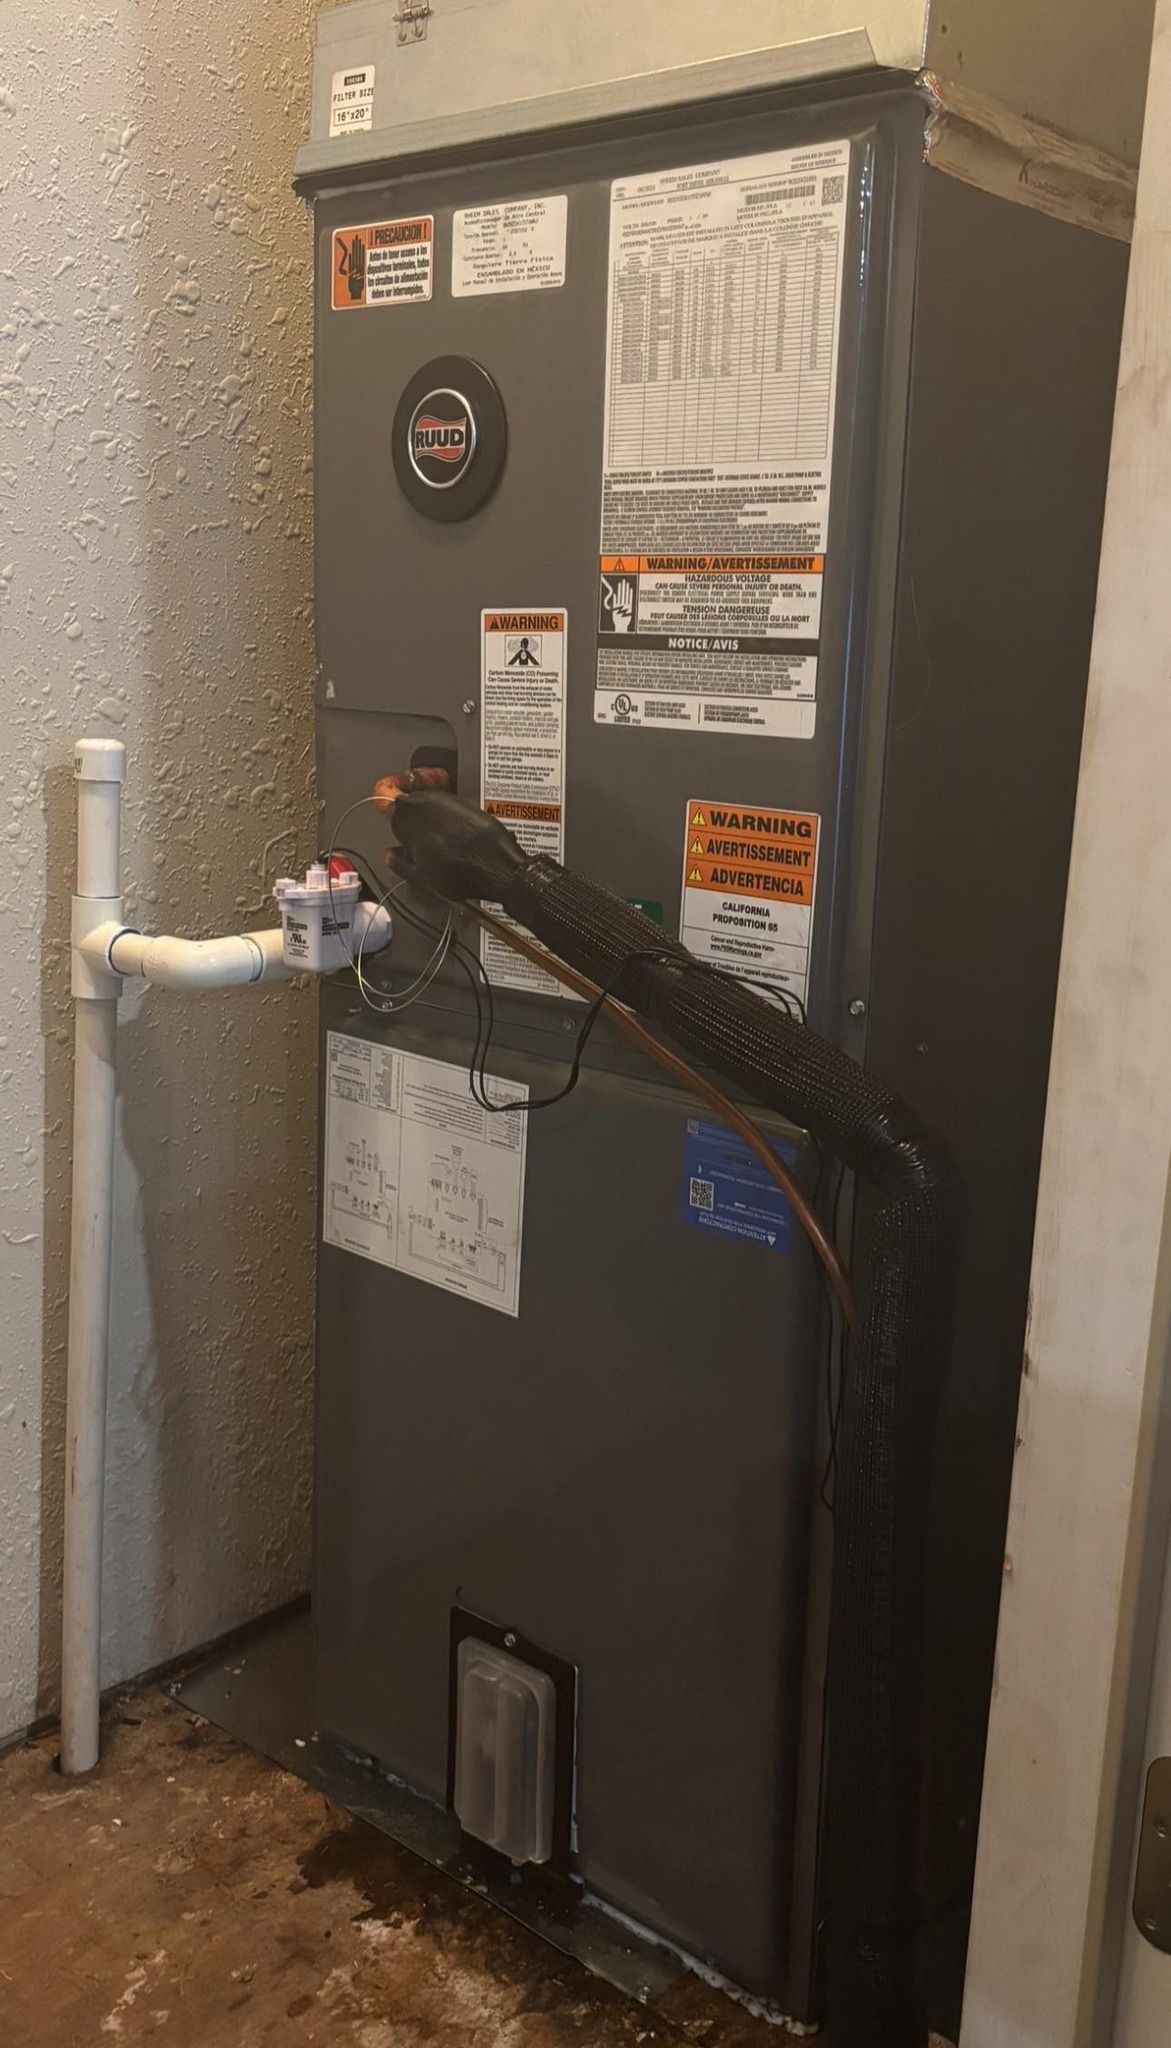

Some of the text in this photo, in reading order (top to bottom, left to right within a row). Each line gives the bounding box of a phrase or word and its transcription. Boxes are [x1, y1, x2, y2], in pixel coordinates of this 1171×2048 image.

[333, 88, 374, 102] FILTER SIZE
[477, 269, 513, 278] ENSAMBLADO
[416, 428, 464, 449] RUUD
[647, 557, 815, 571] WARNING/AVERTISSEMENT
[655, 582, 668, 590] CAN
[682, 605, 770, 614] TENSION DANGEREUSE
[500, 616, 558, 629] WARNING
[668, 637, 739, 650] NOTICE/AVIS
[495, 804, 560, 820] AVERTISSEMENT
[710, 810, 812, 838] WARNING
[707, 838, 811, 867] AVERTISSEMENT
[711, 867, 804, 896] ADVERTENCIA
[722, 902, 770, 918] CALIFORNIA
[713, 913, 778, 932] PROPOSITION 65
[734, 939, 761, 949] Reproductive
